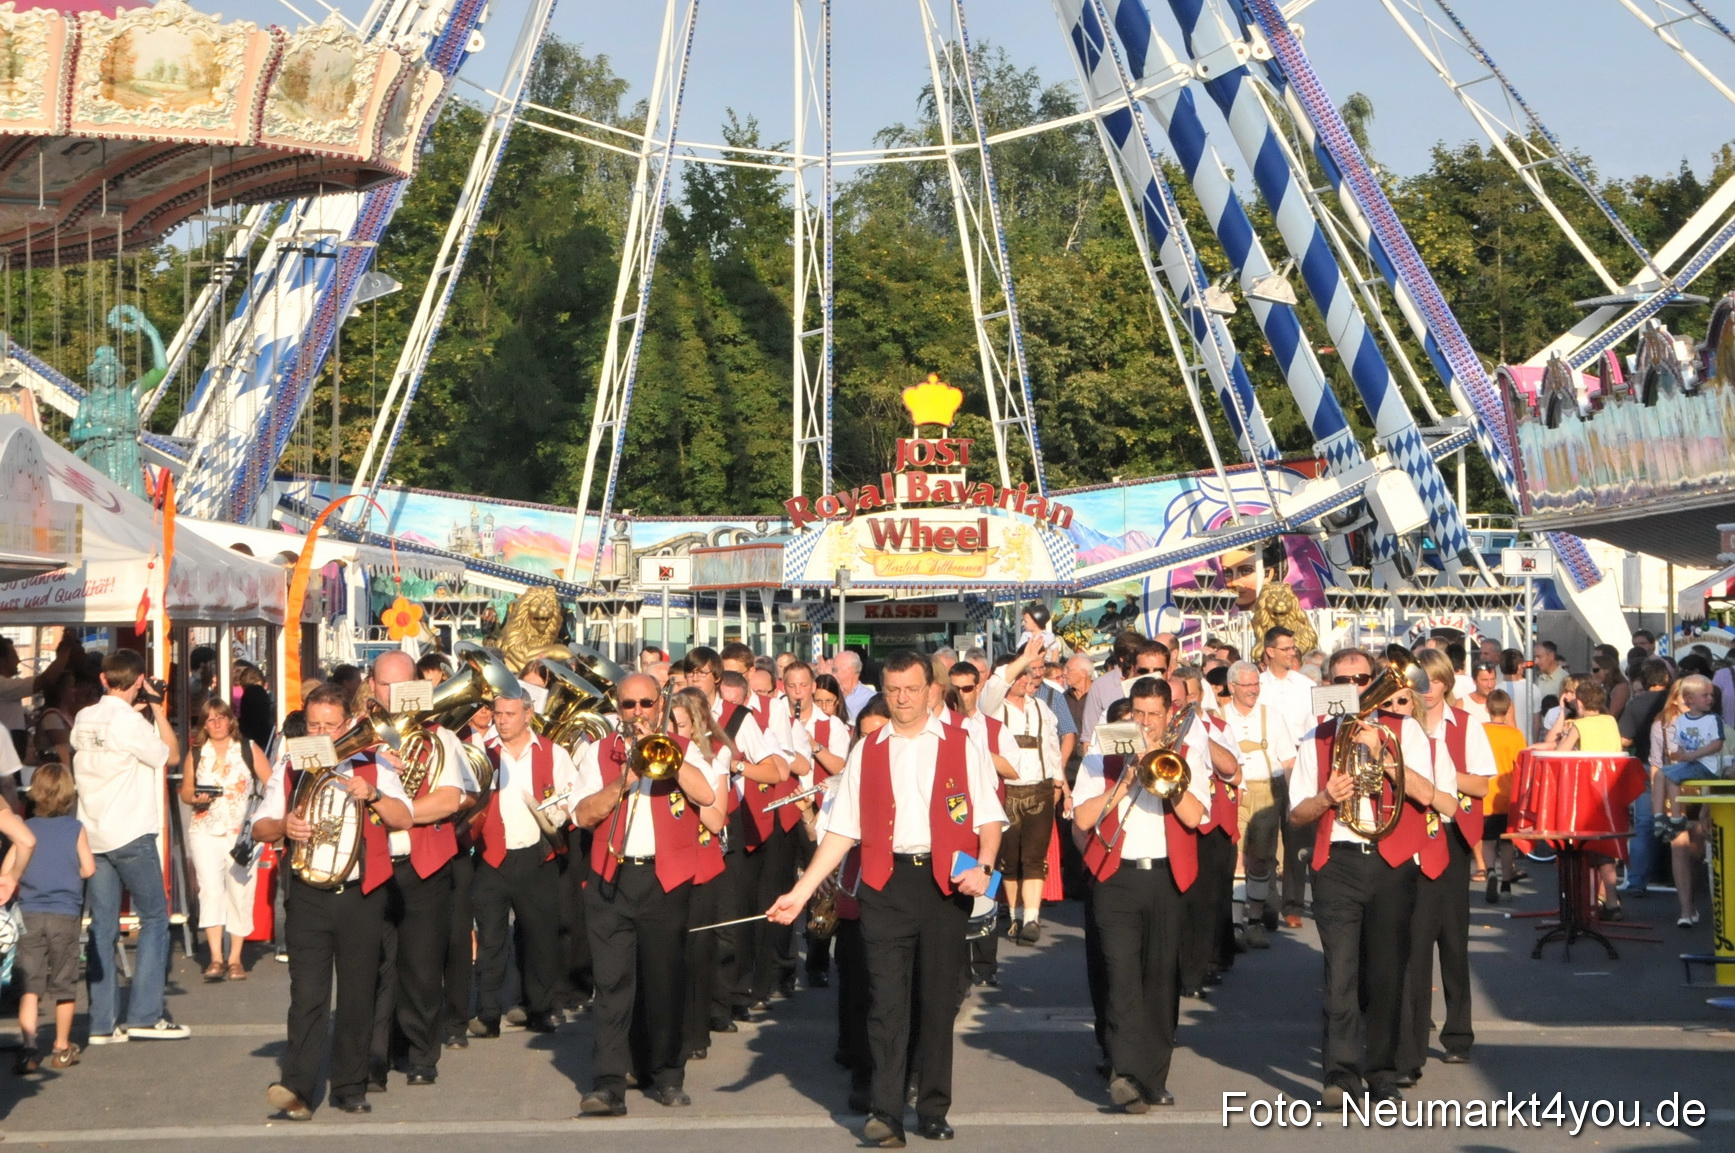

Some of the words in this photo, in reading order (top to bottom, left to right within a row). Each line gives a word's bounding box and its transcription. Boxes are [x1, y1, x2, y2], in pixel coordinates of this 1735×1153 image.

[895, 438, 975, 472] JOST
[783, 472, 896, 529] Royal
[906, 471, 1075, 530] Bavarian
[867, 517, 989, 550] Wheel
[880, 558, 920, 573] Herzlich
[928, 557, 983, 574] Willkommen
[24, 587, 53, 609] und
[55, 577, 116, 604] Qualität!
[864, 604, 939, 619] KASSE
